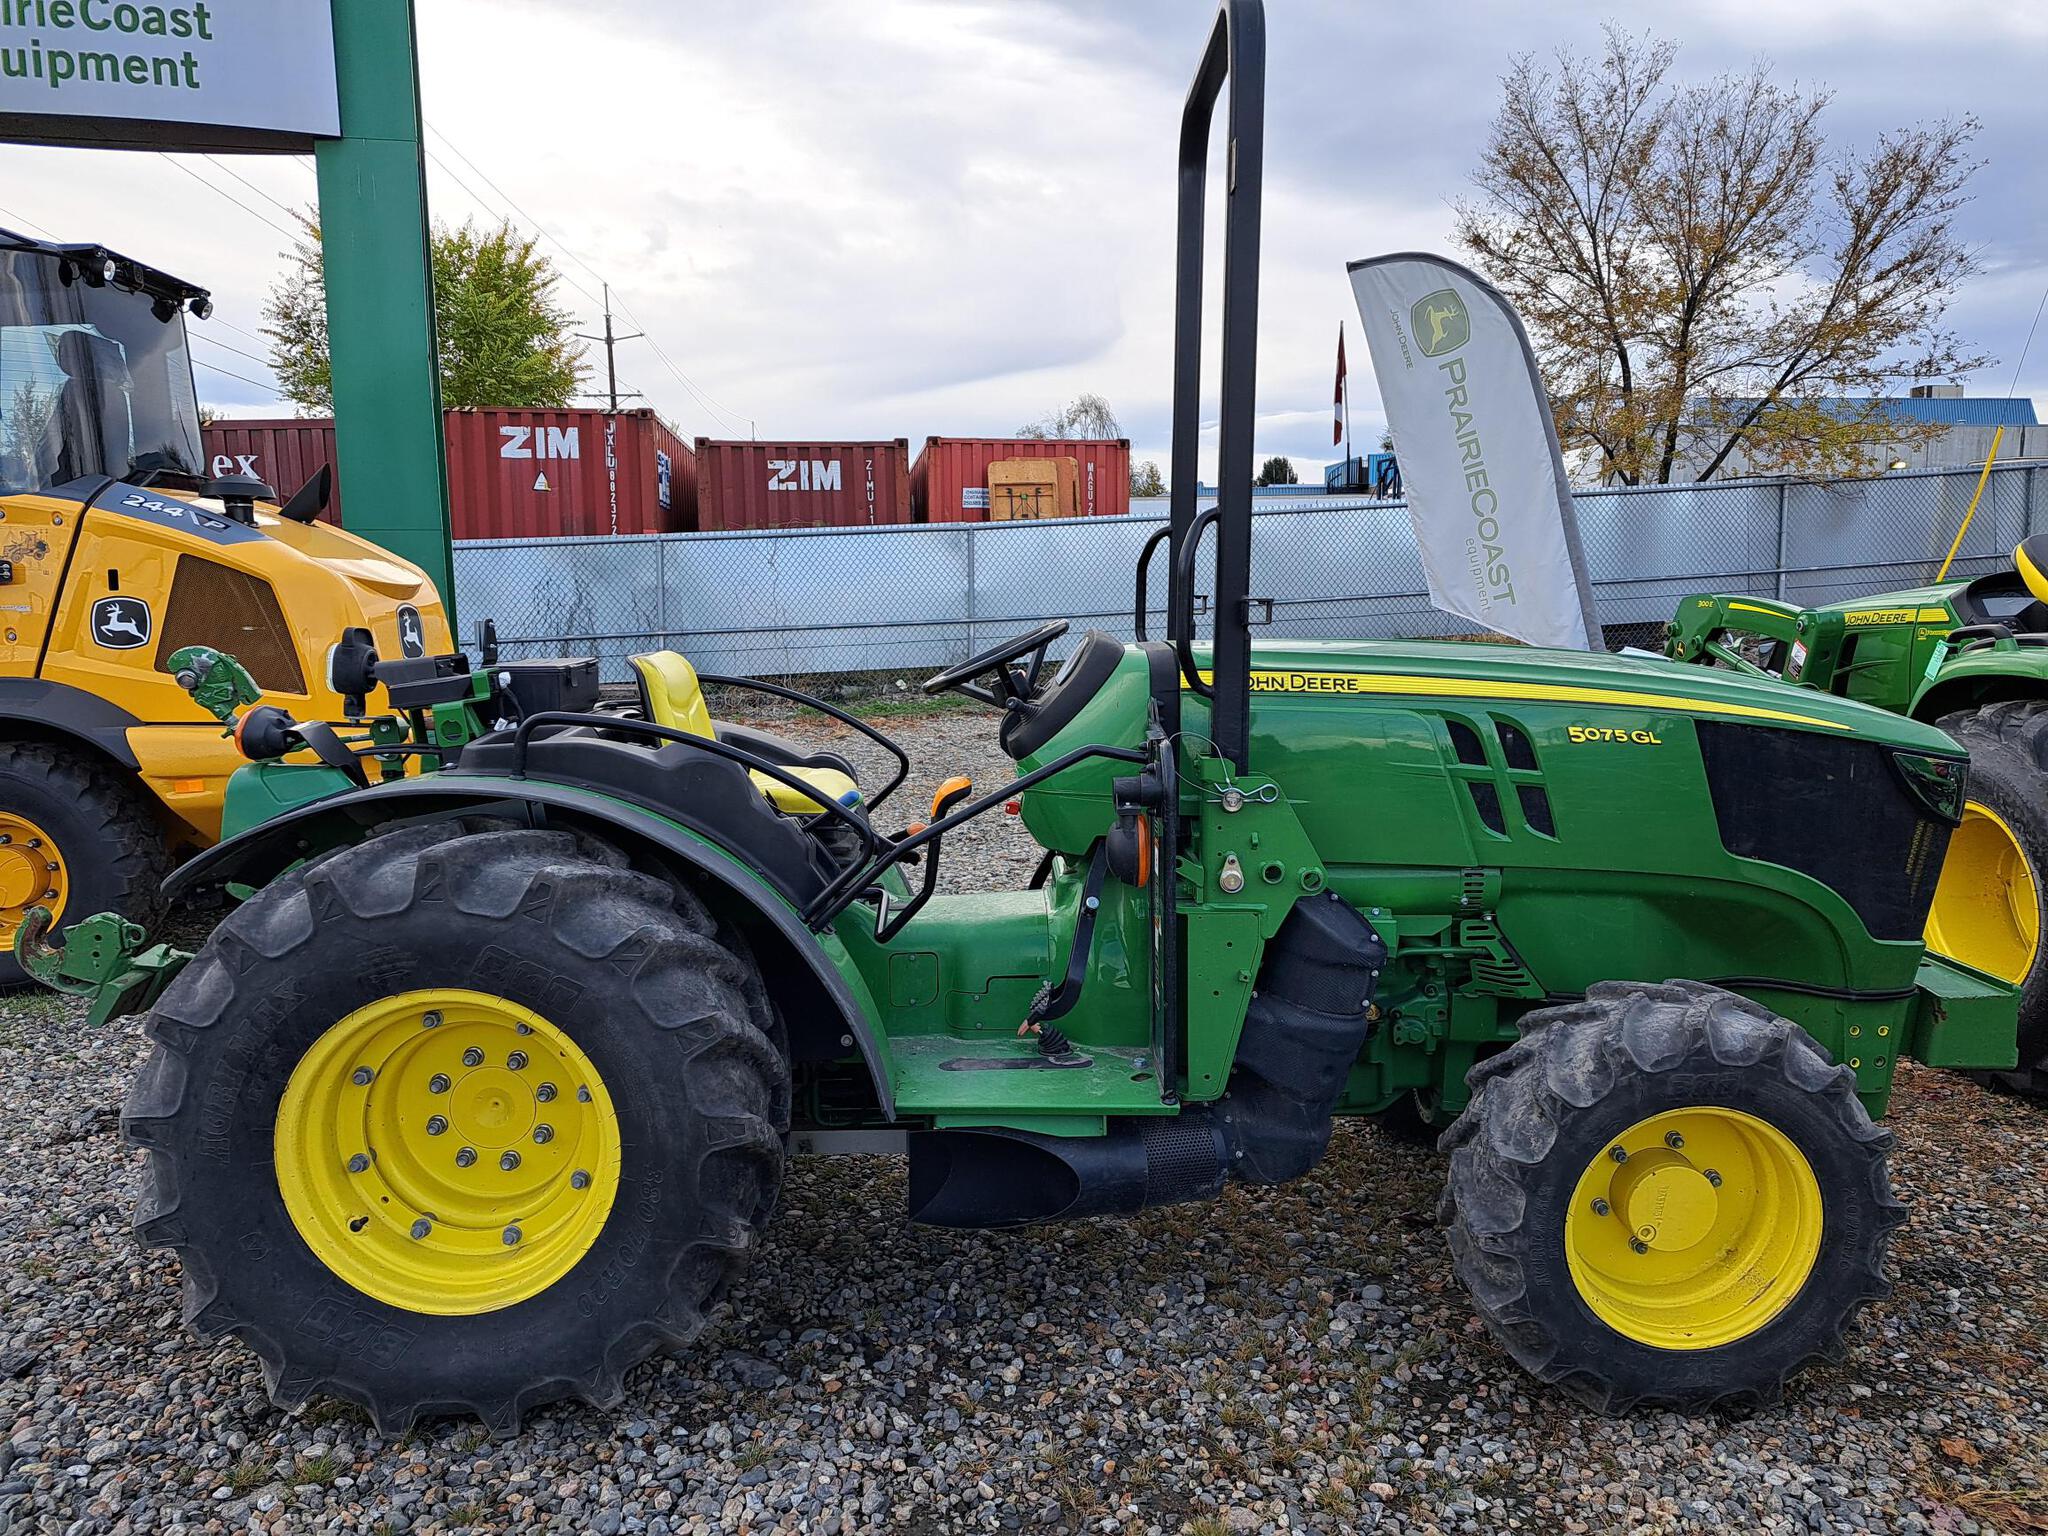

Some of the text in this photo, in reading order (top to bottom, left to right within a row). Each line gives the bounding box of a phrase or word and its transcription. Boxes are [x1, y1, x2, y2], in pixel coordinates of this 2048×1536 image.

[0, 39, 200, 89] uipment
[1390, 309, 1414, 370] JOHN DEERE
[499, 425, 580, 459] ZIM
[606, 421, 616, 468] JXLU
[767, 459, 842, 490] ZIM
[865, 459, 874, 501] ZIMU
[1438, 357, 1516, 605] PRAIRIECOAST
[121, 494, 187, 518] 244
[1465, 537, 1492, 613] equipment
[1846, 612, 1908, 625] JOHN DEERE
[1290, 674, 1359, 691] DEERE
[1567, 726, 1663, 745] 5075 GL
